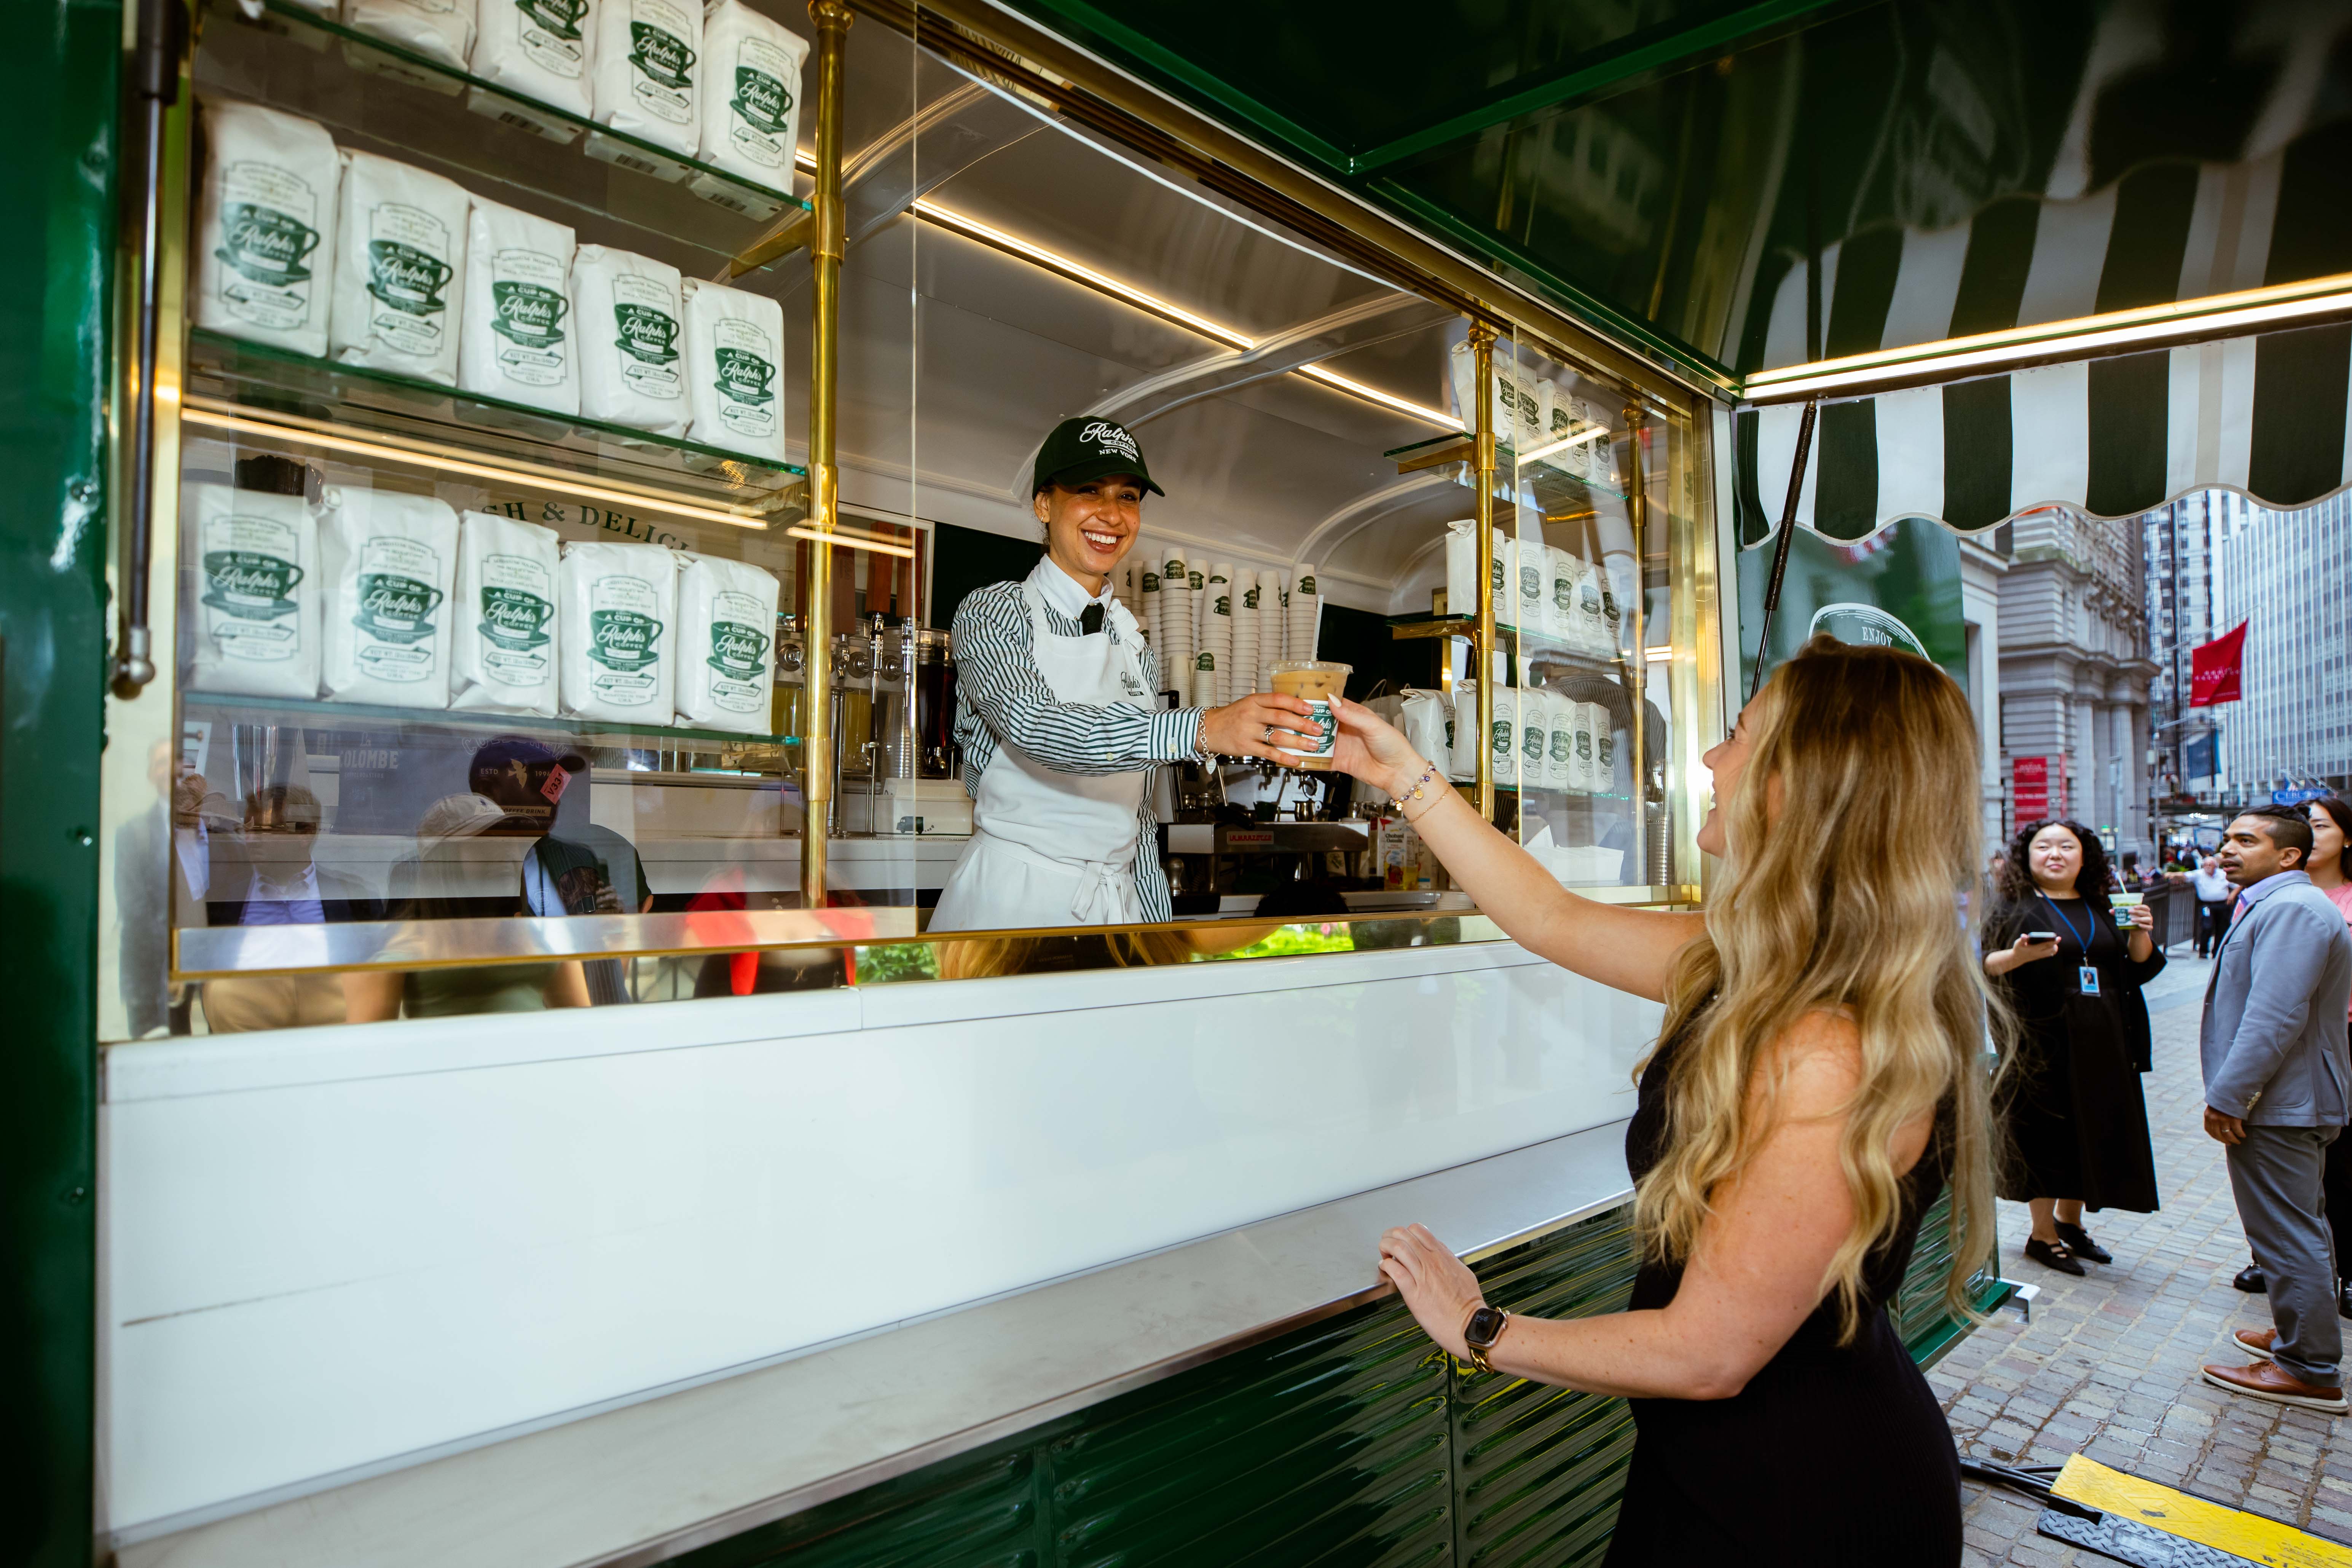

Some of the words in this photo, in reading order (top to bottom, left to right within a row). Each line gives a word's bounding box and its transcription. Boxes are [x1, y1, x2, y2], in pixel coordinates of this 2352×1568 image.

[652, 30, 668, 41] CUP
[756, 75, 772, 86] CUP
[739, 81, 780, 110] Ralph's
[755, 100, 777, 115] COFFEE
[518, 287, 538, 296] CUP
[499, 295, 552, 323] Ralph's
[636, 309, 652, 318] CUP
[520, 316, 551, 326] COFFEE
[622, 316, 667, 341] Ralph's
[640, 335, 666, 345] COFFEE
[735, 353, 750, 361] CUP
[721, 360, 762, 383] Ralph's
[738, 377, 761, 386] COFFEE
[1080, 422, 1137, 448] Ralph's
[1111, 440, 1135, 452] COFFEE
[1120, 450, 1137, 463] YORK
[542, 501, 566, 522] &
[386, 580, 409, 589] CUP
[364, 589, 423, 617] Ralph's
[504, 593, 523, 601] CUP
[486, 601, 537, 627] Ralph's
[503, 621, 534, 630] COFFEE
[596, 623, 646, 649] Ralph's
[1862, 627, 1893, 648] ENJOY
[715, 634, 757, 659] Ralph's
[732, 652, 755, 661] COFFEE
[1121, 672, 1140, 691] Ralph's
[1494, 728, 1509, 742] Ralph's
[547, 772, 564, 795] V331
